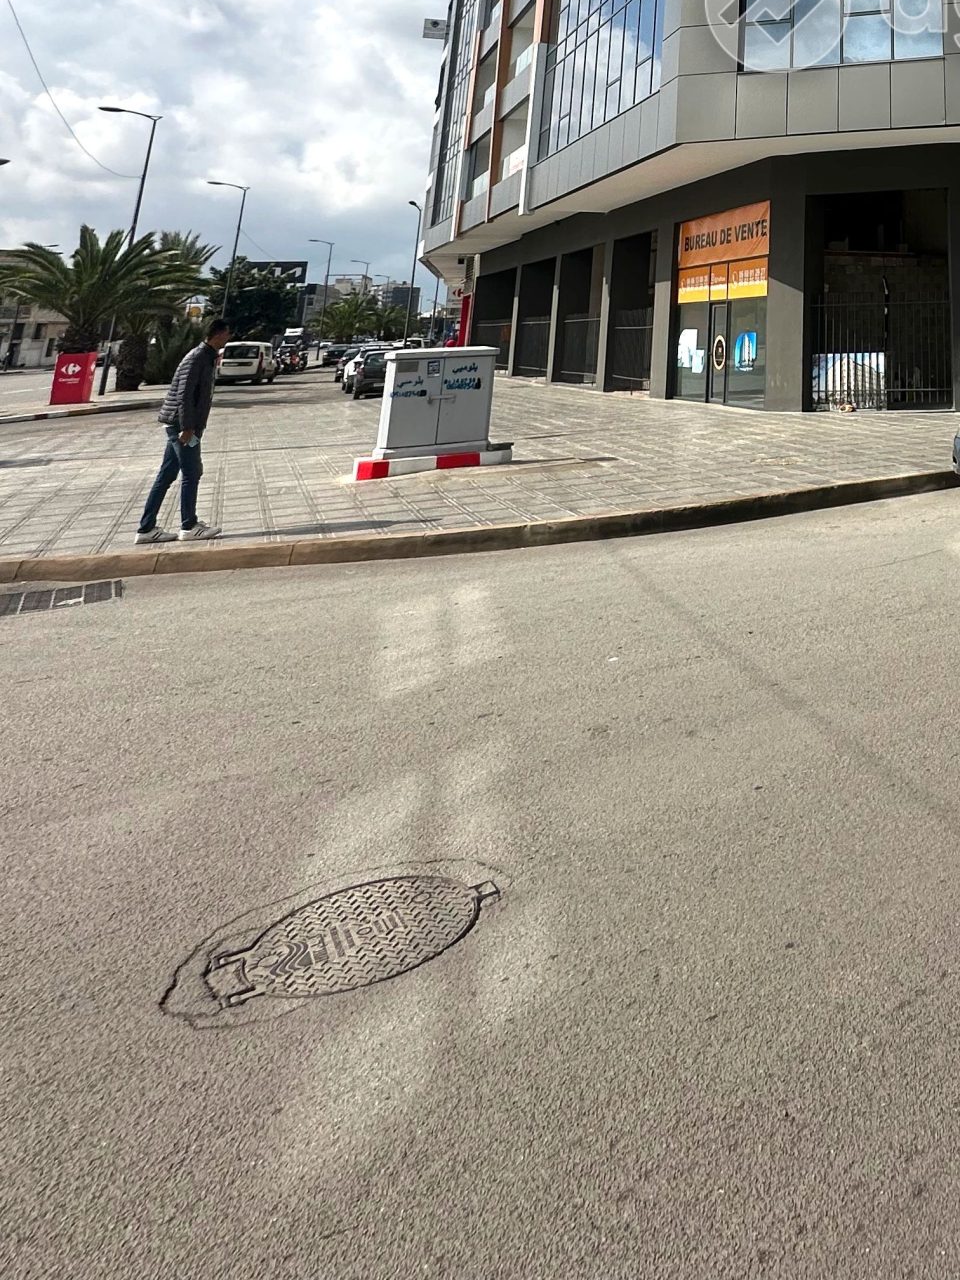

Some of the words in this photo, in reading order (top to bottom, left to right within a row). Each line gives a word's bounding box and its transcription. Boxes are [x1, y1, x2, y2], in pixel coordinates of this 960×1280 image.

[684, 230, 718, 252] BUREAU
[719, 227, 732, 245] DE
[734, 219, 768, 242] VENTE
